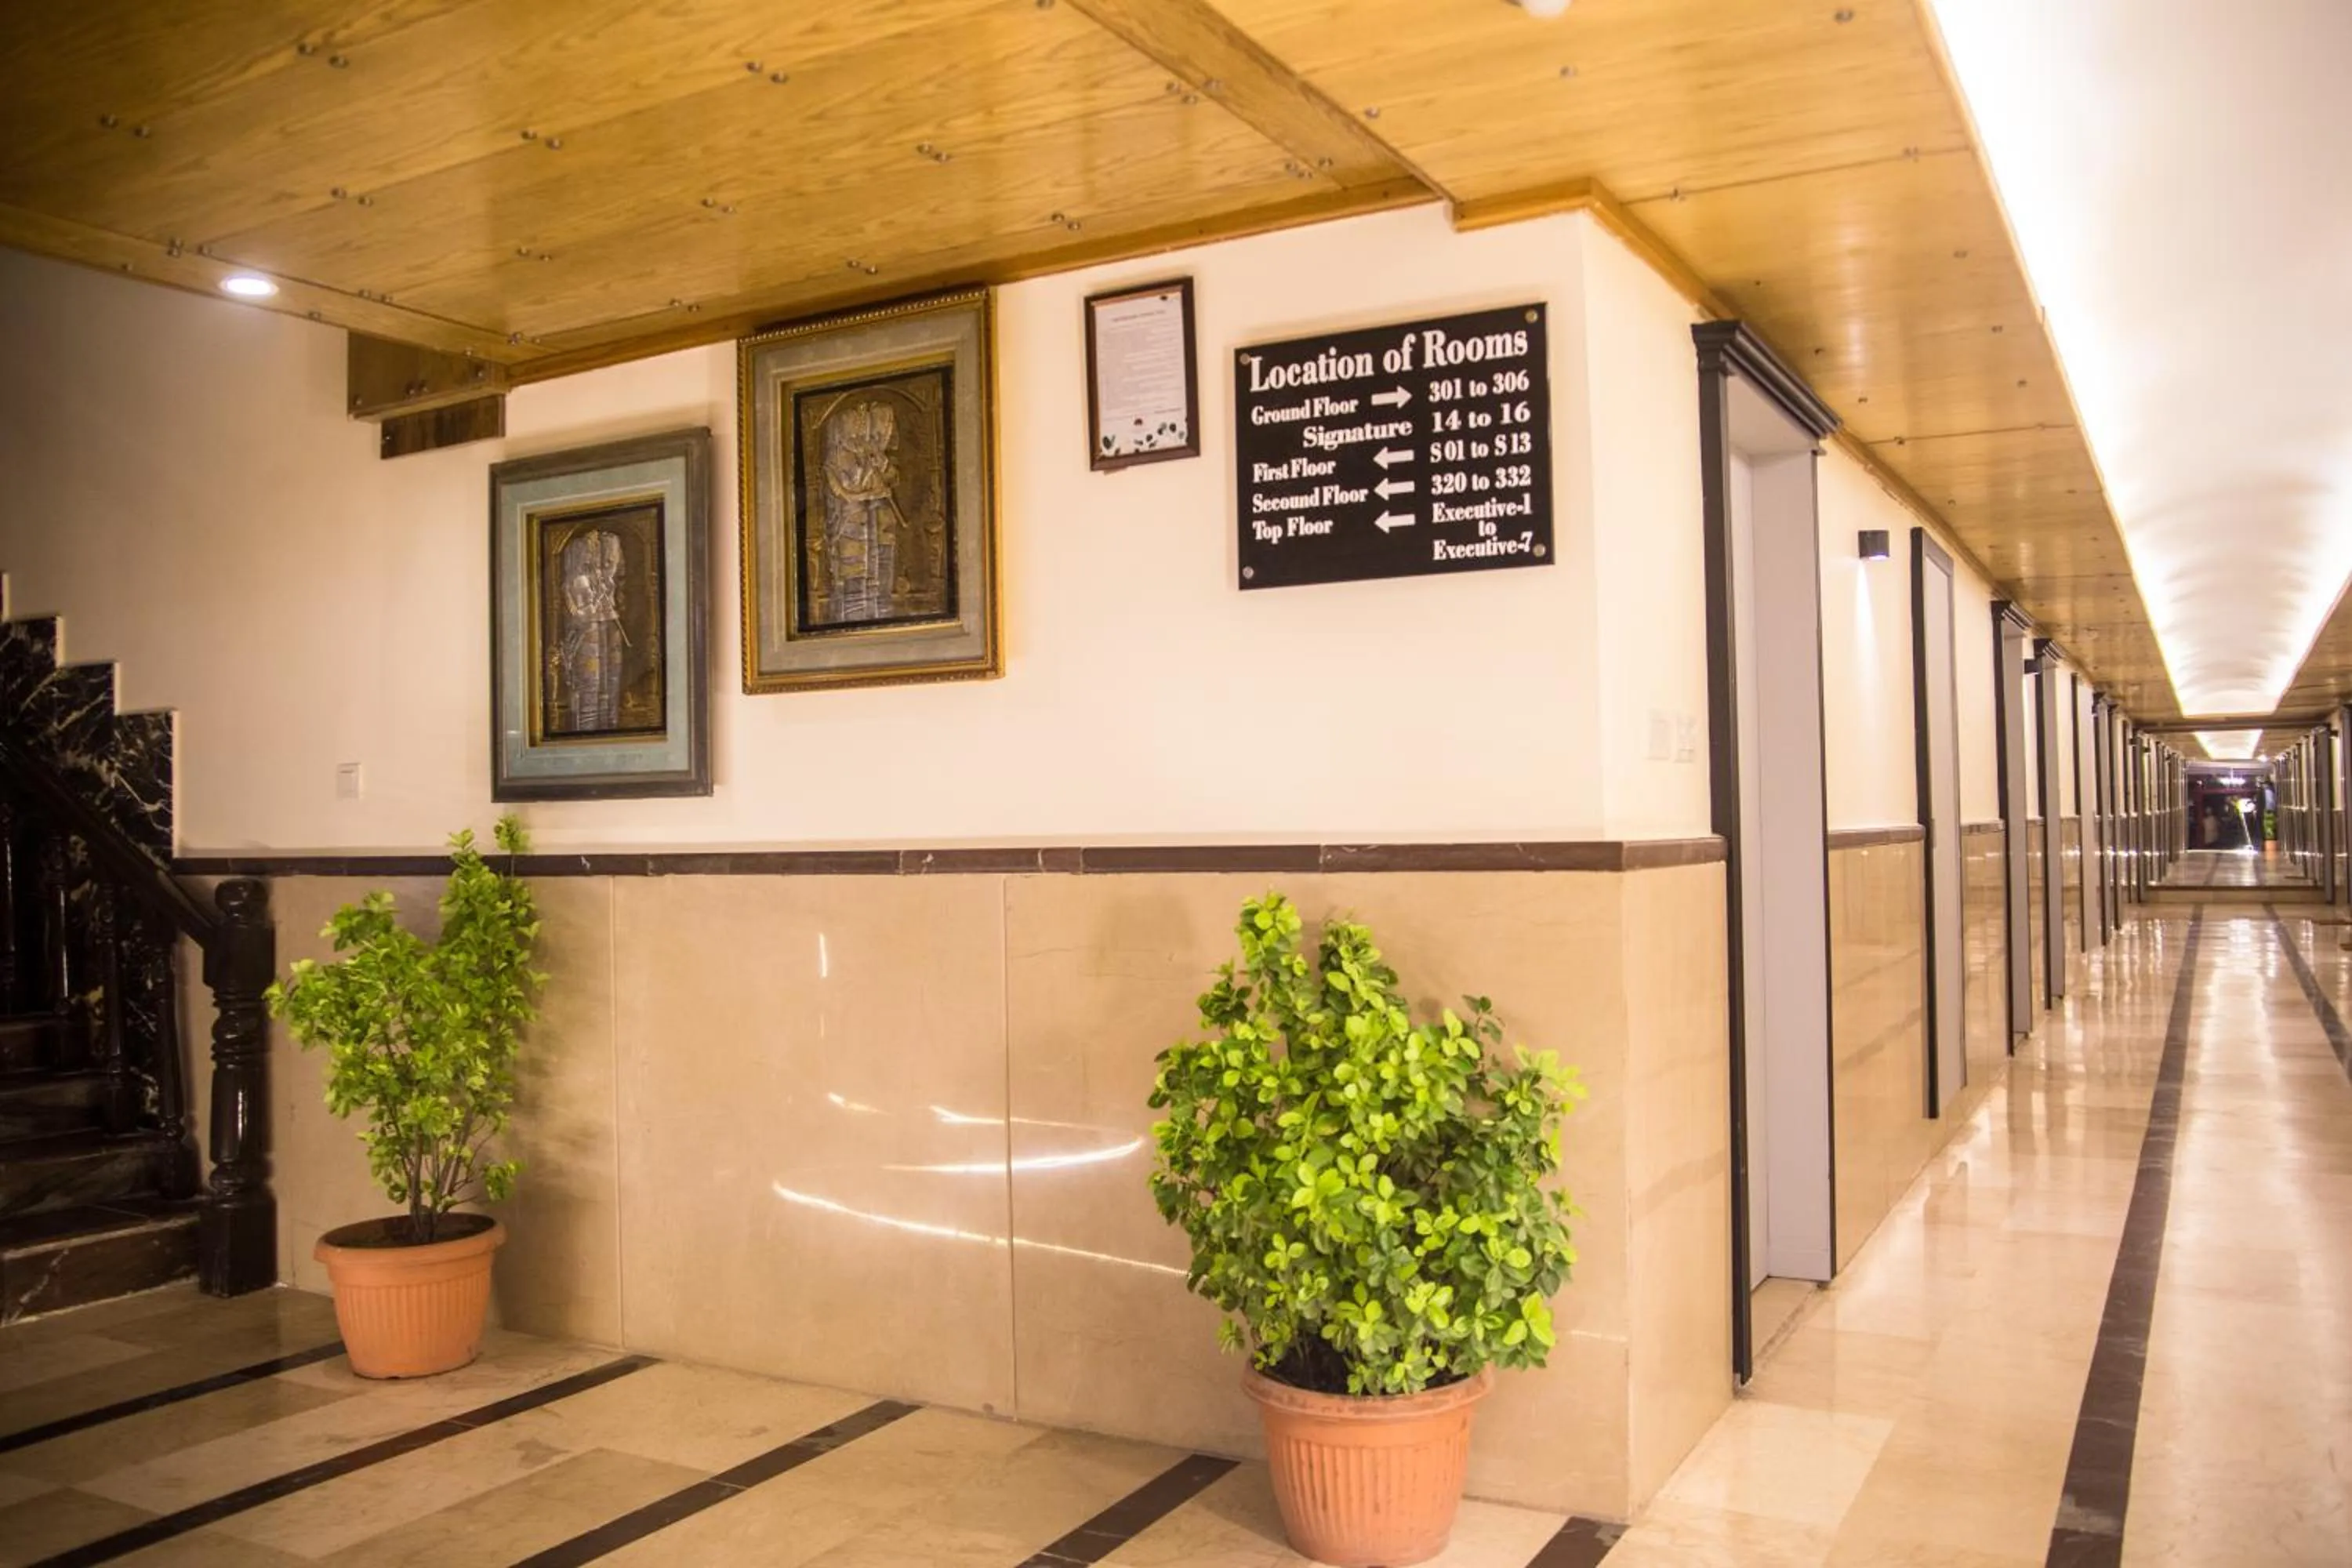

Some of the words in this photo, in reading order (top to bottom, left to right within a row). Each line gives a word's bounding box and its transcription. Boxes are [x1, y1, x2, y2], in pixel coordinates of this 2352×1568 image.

[1250, 347, 1374, 392] Location
[1382, 333, 1417, 373] of
[1422, 329, 1528, 368] Rooms
[1428, 378, 1463, 402] 301
[1468, 379, 1488, 397] to
[1492, 369, 1530, 394] 306
[1250, 398, 1311, 426] Ground
[1312, 396, 1359, 418] Floor
[1432, 409, 1462, 433] 14
[1468, 411, 1492, 429] to
[1501, 401, 1531, 424] 16
[1302, 421, 1413, 451] Signature
[1470, 441, 1490, 459] to
[1253, 463, 1290, 483] First
[1290, 457, 1337, 479] Floor
[1431, 472, 1468, 495] 320
[1472, 474, 1490, 492] to
[1494, 464, 1531, 489] 332
[1252, 486, 1320, 514] Secound
[1323, 485, 1369, 506] Floor
[1252, 520, 1283, 545] Top
[1287, 515, 1334, 537] Floor
[1478, 520, 1497, 537] to
